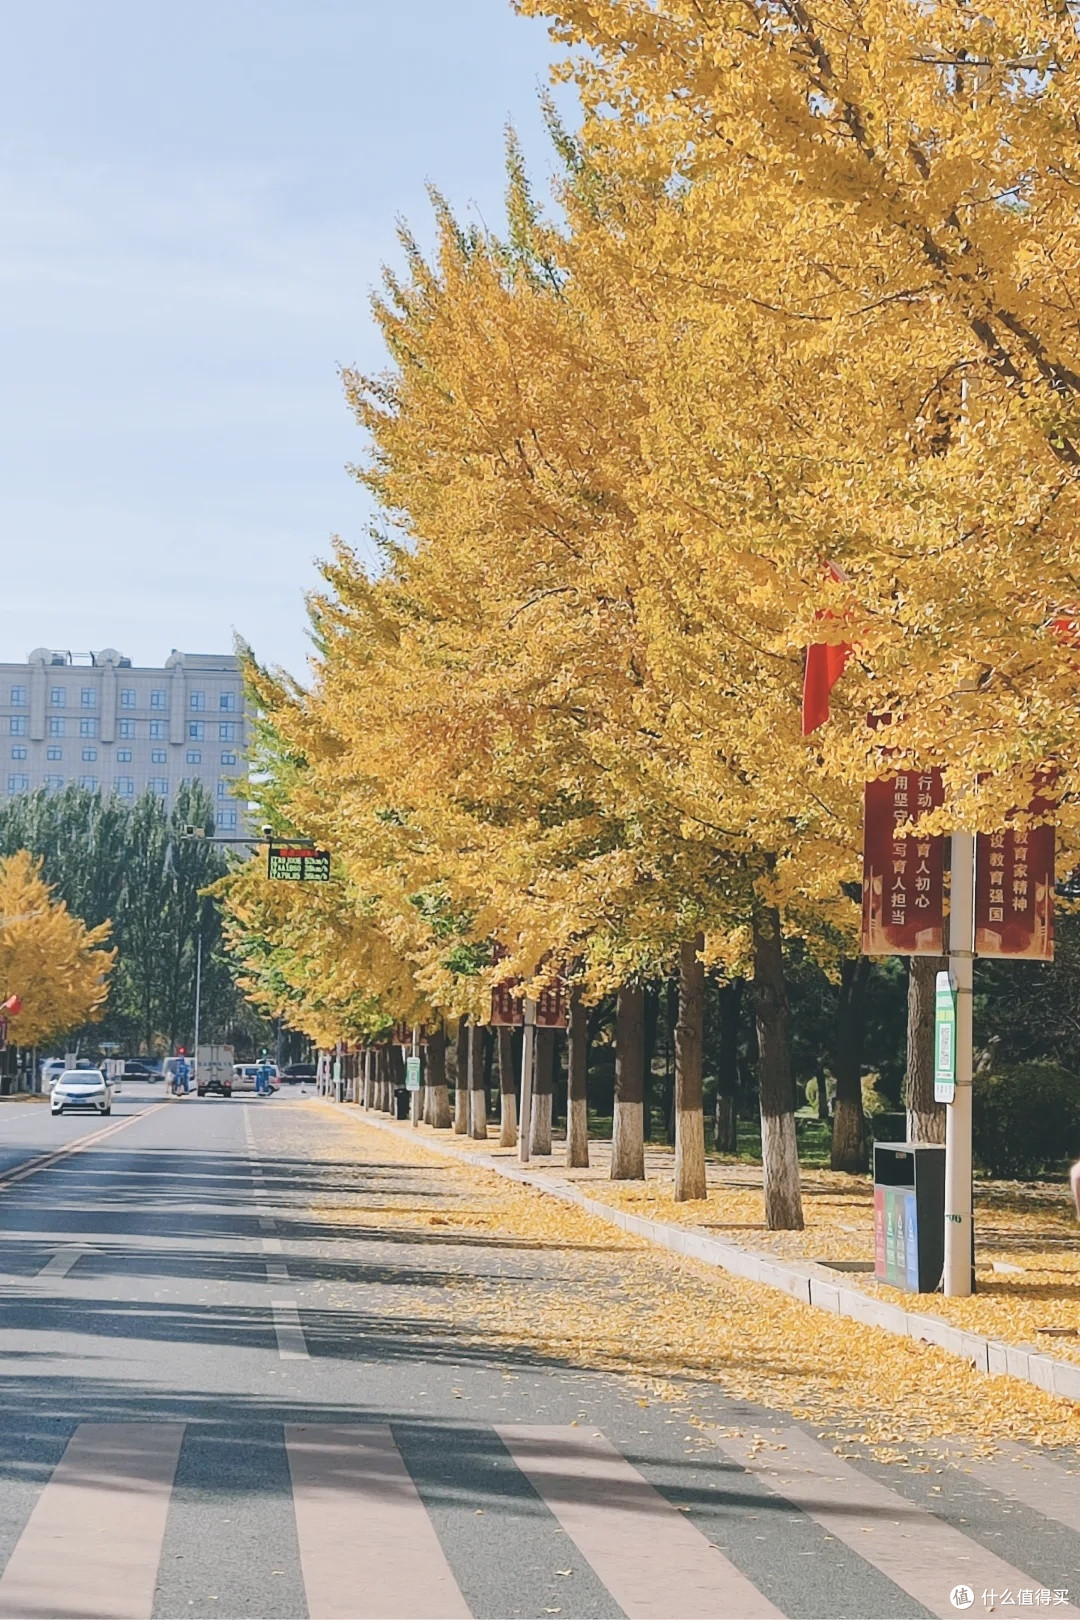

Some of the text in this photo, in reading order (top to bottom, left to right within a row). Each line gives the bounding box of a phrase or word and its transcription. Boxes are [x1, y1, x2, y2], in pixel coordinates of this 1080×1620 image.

[891, 776, 908, 925] 用坚守写育人担当
